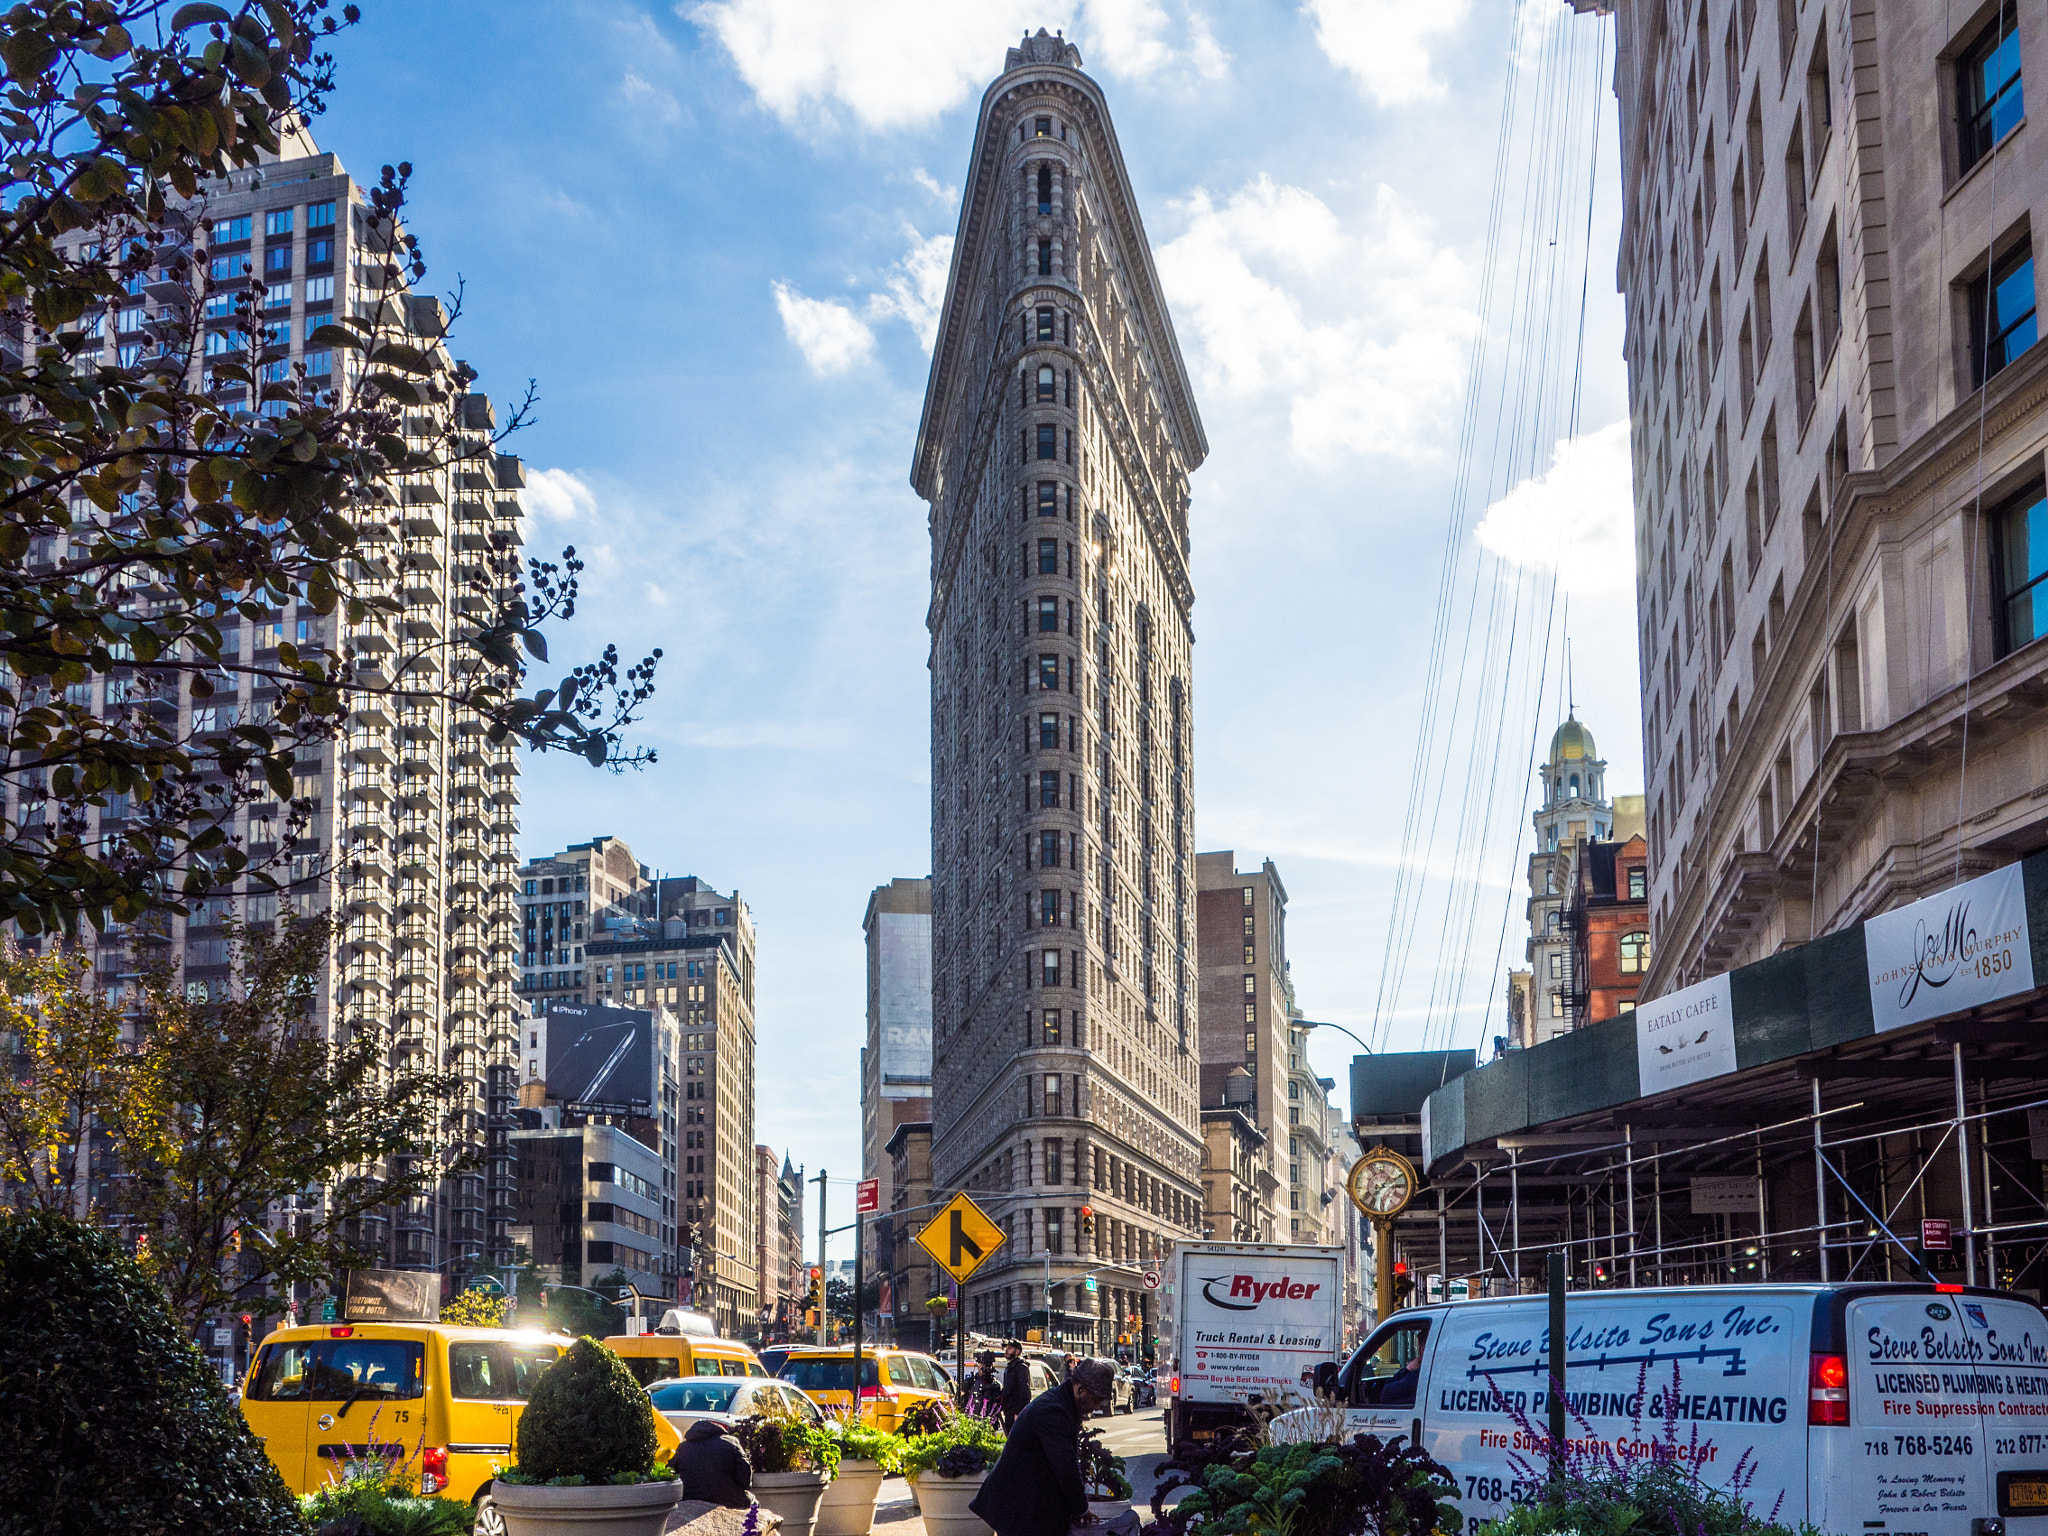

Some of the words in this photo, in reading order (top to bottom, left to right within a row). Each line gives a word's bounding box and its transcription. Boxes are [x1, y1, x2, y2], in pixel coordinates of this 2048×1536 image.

[1875, 956, 1944, 986] JOHNSTON
[1948, 953, 1957, 963] &
[1964, 926, 2022, 957] MURPHY
[1974, 949, 2012, 979] 1850
[558, 1006, 582, 1016] iPhone
[1648, 1008, 1682, 1032] EATALY
[1937, 1248, 2012, 1270] EAAY
[1229, 1275, 1320, 1303] Ryder
[348, 1306, 365, 1314] YOUR
[365, 1306, 387, 1315] BOTTLE
[1196, 1331, 1225, 1343] Truck
[1228, 1332, 1264, 1344] Rental
[1267, 1334, 1276, 1344] &
[1279, 1334, 1321, 1348] Leasing
[1469, 1332, 1531, 1361] Steve
[1539, 1325, 1631, 1355] Blsito
[1640, 1313, 1714, 1345] Sons
[1723, 1305, 1780, 1338] Inc.
[1868, 1326, 1919, 1360] Steve
[1920, 1325, 1983, 1360] Belsito
[1987, 1330, 2025, 1362] Sons
[1210, 1352, 1260, 1361] 1-800-BY-RYDER
[1210, 1364, 1260, 1373] www.ryder.com
[1210, 1375, 1222, 1384] Buy
[1252, 1376, 1269, 1384] Used
[1270, 1377, 1293, 1385] Trucks
[1875, 1374, 1940, 1393] LICENSED
[1943, 1374, 2003, 1394] PLUMBING
[2006, 1376, 2014, 1393] &
[1440, 1389, 1527, 1413] LICENSED
[1532, 1391, 1638, 1417] PMBING
[1648, 1394, 1664, 1419] &
[1674, 1396, 1788, 1424] HEATING
[1883, 1400, 1912, 1415] Fire
[1916, 1401, 1995, 1418] Suppression
[395, 1411, 409, 1423] 75
[1480, 1429, 1508, 1449] Fire
[1864, 1442, 1889, 1456] 718
[1894, 1435, 1973, 1456] 768-5246
[1995, 1439, 2015, 1454] 212
[1877, 1475, 1887, 1484] In
[1890, 1474, 1919, 1485] Loving
[1922, 1474, 1955, 1484] Memory
[1958, 1474, 1966, 1485] of
[1878, 1489, 1897, 1500] John
[1900, 1489, 1907, 1498] &
[1910, 1489, 1937, 1498] Robert
[1940, 1488, 1966, 1497] Belsito
[1878, 1504, 1909, 1514] Forever
[1923, 1503, 1938, 1512] Our
[1941, 1502, 1967, 1511] Hearts
